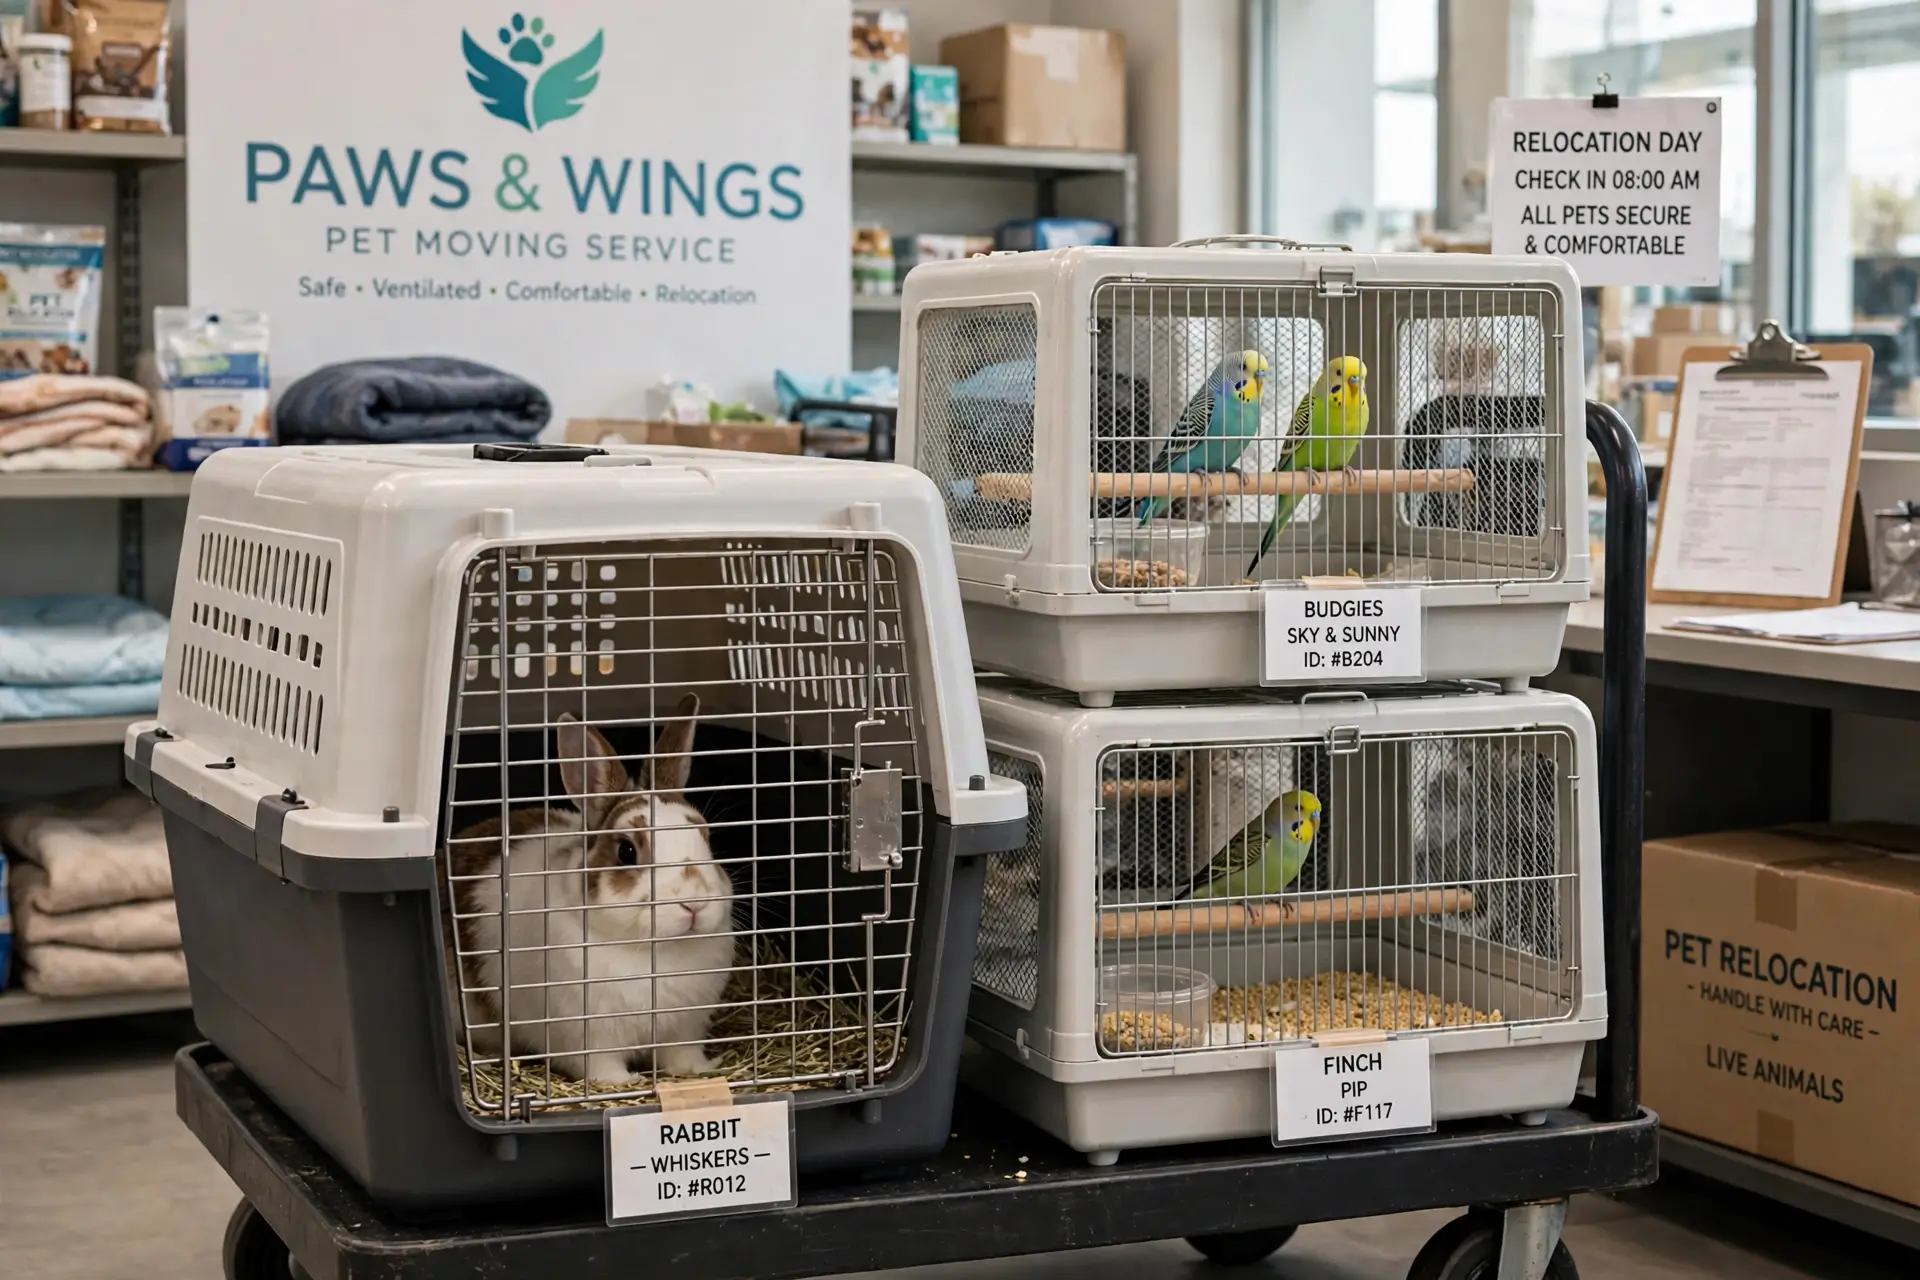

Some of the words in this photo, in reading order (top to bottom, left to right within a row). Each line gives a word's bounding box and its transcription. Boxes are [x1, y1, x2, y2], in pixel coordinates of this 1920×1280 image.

[1513, 131, 1651, 153] RELOCATION
[1659, 131, 1703, 153] DAY
[245, 141, 471, 211] PAWS
[494, 152, 542, 213] &
[560, 154, 805, 222] WINGS
[1515, 169, 1581, 190] CHECK
[1587, 170, 1606, 190] IN
[1612, 170, 1665, 190] 08:00
[1670, 170, 1700, 190] AM
[1520, 205, 1557, 226] ALL
[1563, 205, 1610, 226] PETS
[1615, 205, 1692, 226] SECURE
[326, 225, 398, 254] PET
[415, 228, 568, 260] MOVING
[586, 233, 736, 264] SERVICE
[1524, 234, 1538, 255] &
[1544, 234, 1686, 255] COMFORTABLE
[298, 275, 347, 298] Safe
[371, 278, 482, 300] Ventilated
[505, 281, 632, 304] Comfortable
[655, 284, 757, 305] Relocation
[1304, 600, 1384, 618] BUDGIES
[1287, 627, 1320, 644] SKY
[1325, 626, 1337, 643] &
[1342, 626, 1401, 643] SUNNY
[1304, 651, 1326, 668] ID:
[1330, 650, 1384, 667] #B204
[1664, 928, 1713, 968] PET
[1719, 941, 1898, 1013] RELOCATION
[1700, 981, 1765, 1016] HANDLE
[1769, 998, 1813, 1027] WITH
[1818, 1010, 1865, 1041] CARE
[1323, 1052, 1383, 1076] FINCH
[1706, 1043, 1749, 1078] LIVE
[1753, 1058, 1845, 1105] ANIMALS
[1341, 1080, 1368, 1099] PIP
[1316, 1108, 1338, 1125] ID:
[1343, 1102, 1393, 1123] #F117
[660, 1117, 742, 1146] RABBIT
[650, 1147, 750, 1175] WHISKERS
[657, 1180, 682, 1201] ID:
[687, 1174, 747, 1198] #R012
